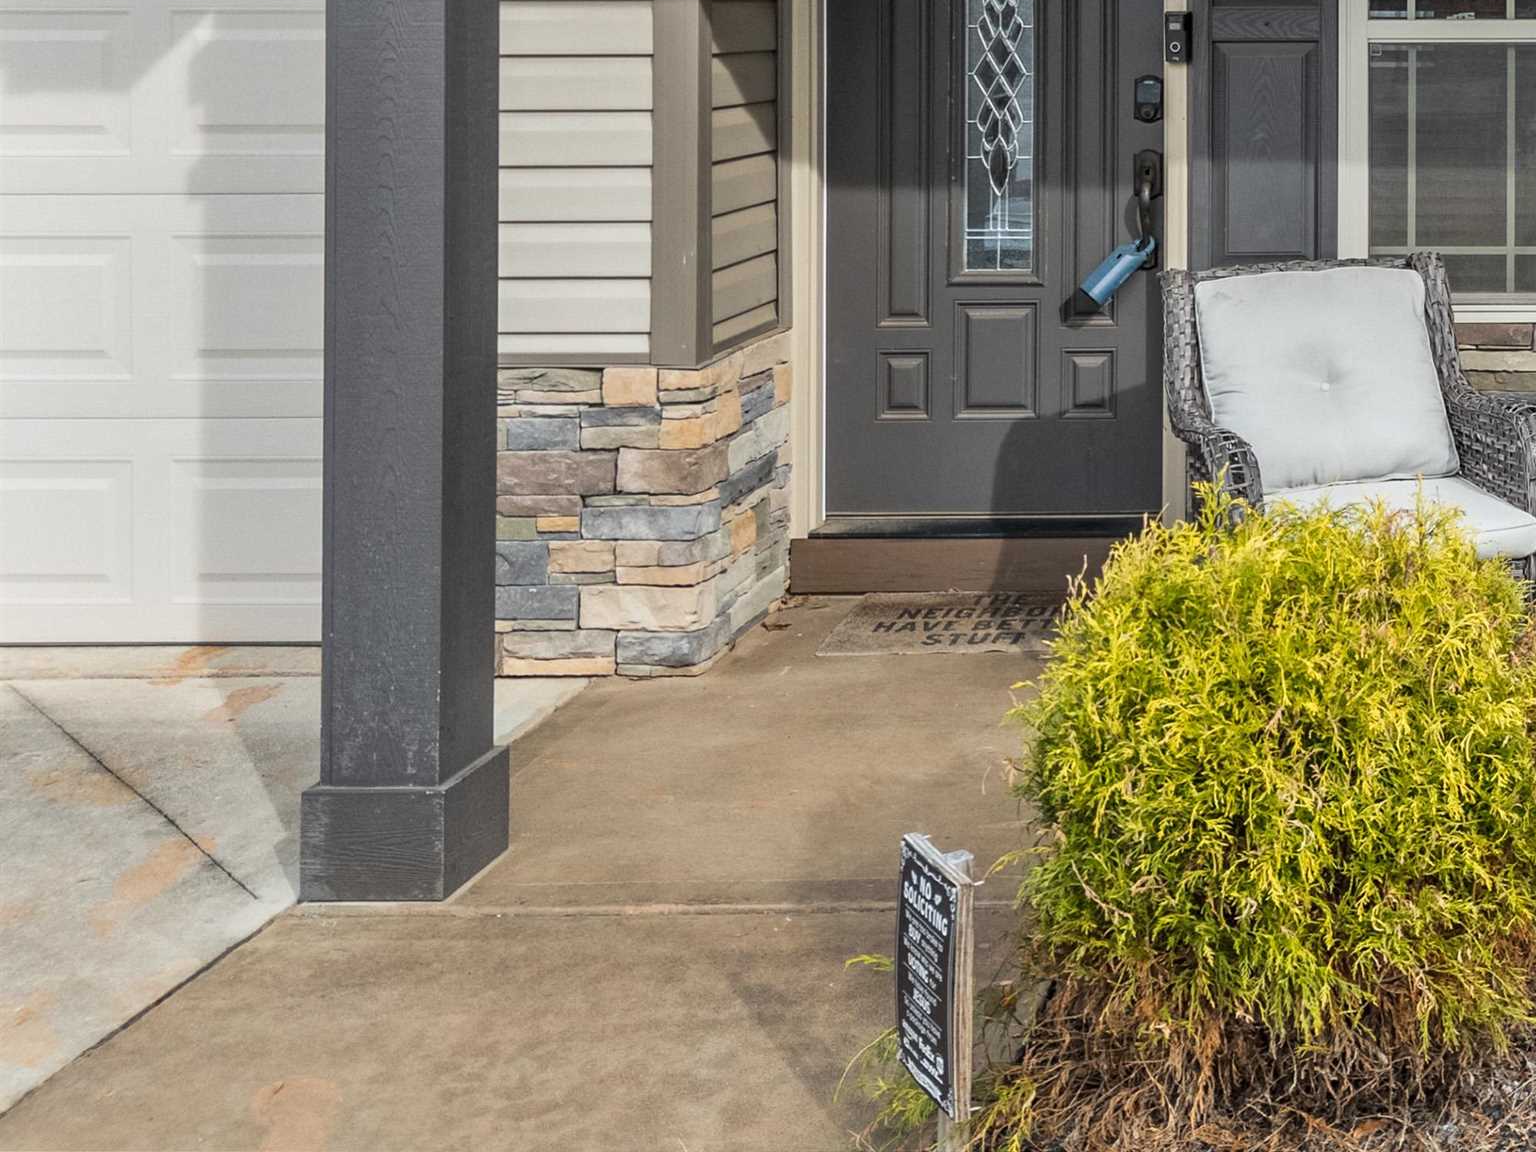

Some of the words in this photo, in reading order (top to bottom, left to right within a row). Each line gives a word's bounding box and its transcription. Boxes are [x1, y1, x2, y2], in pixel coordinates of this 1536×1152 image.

[872, 621, 959, 633] HAVE
[971, 619, 1052, 631] BETT
[921, 632, 1026, 645] STUFF
[920, 876, 932, 900] NO
[904, 881, 948, 936] SOLICITING
